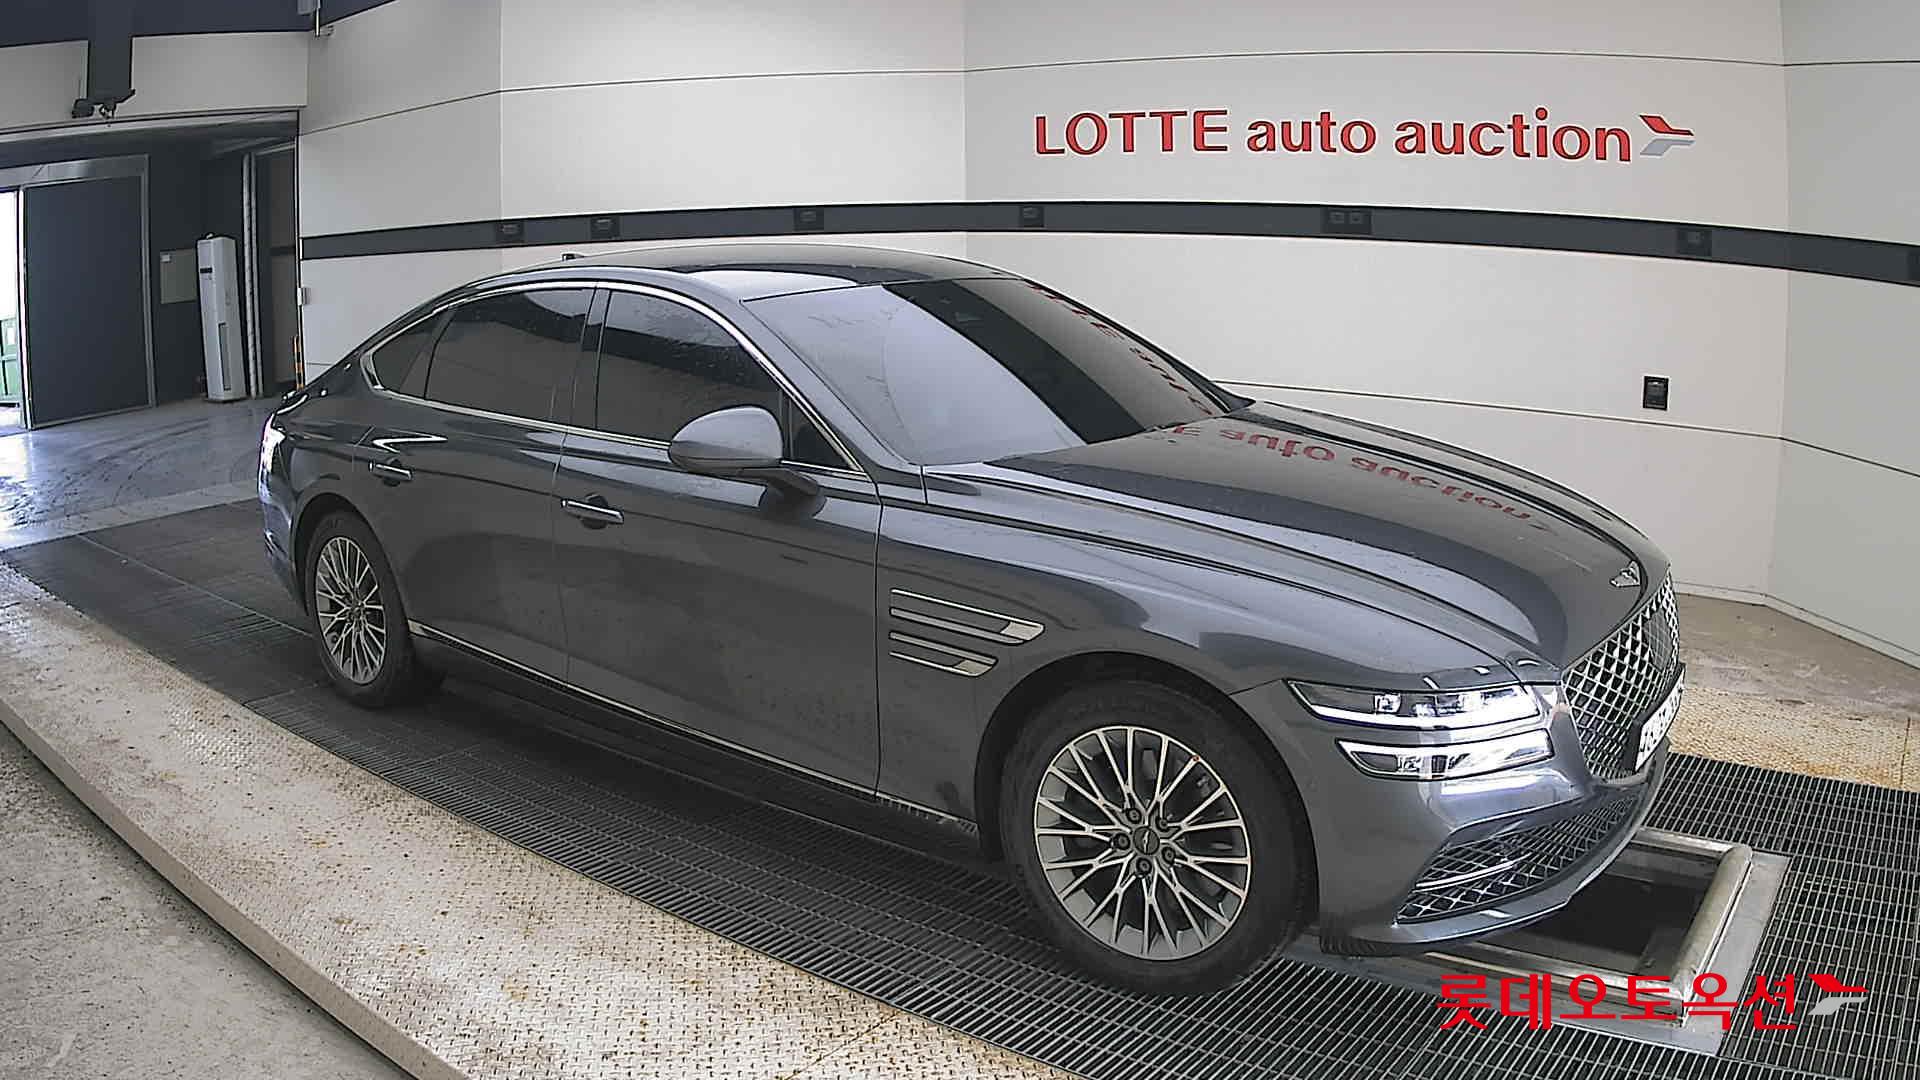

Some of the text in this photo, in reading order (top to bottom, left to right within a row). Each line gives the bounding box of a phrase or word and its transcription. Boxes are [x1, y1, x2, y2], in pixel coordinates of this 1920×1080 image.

[1034, 107, 1633, 163] LOTTE auto auction
